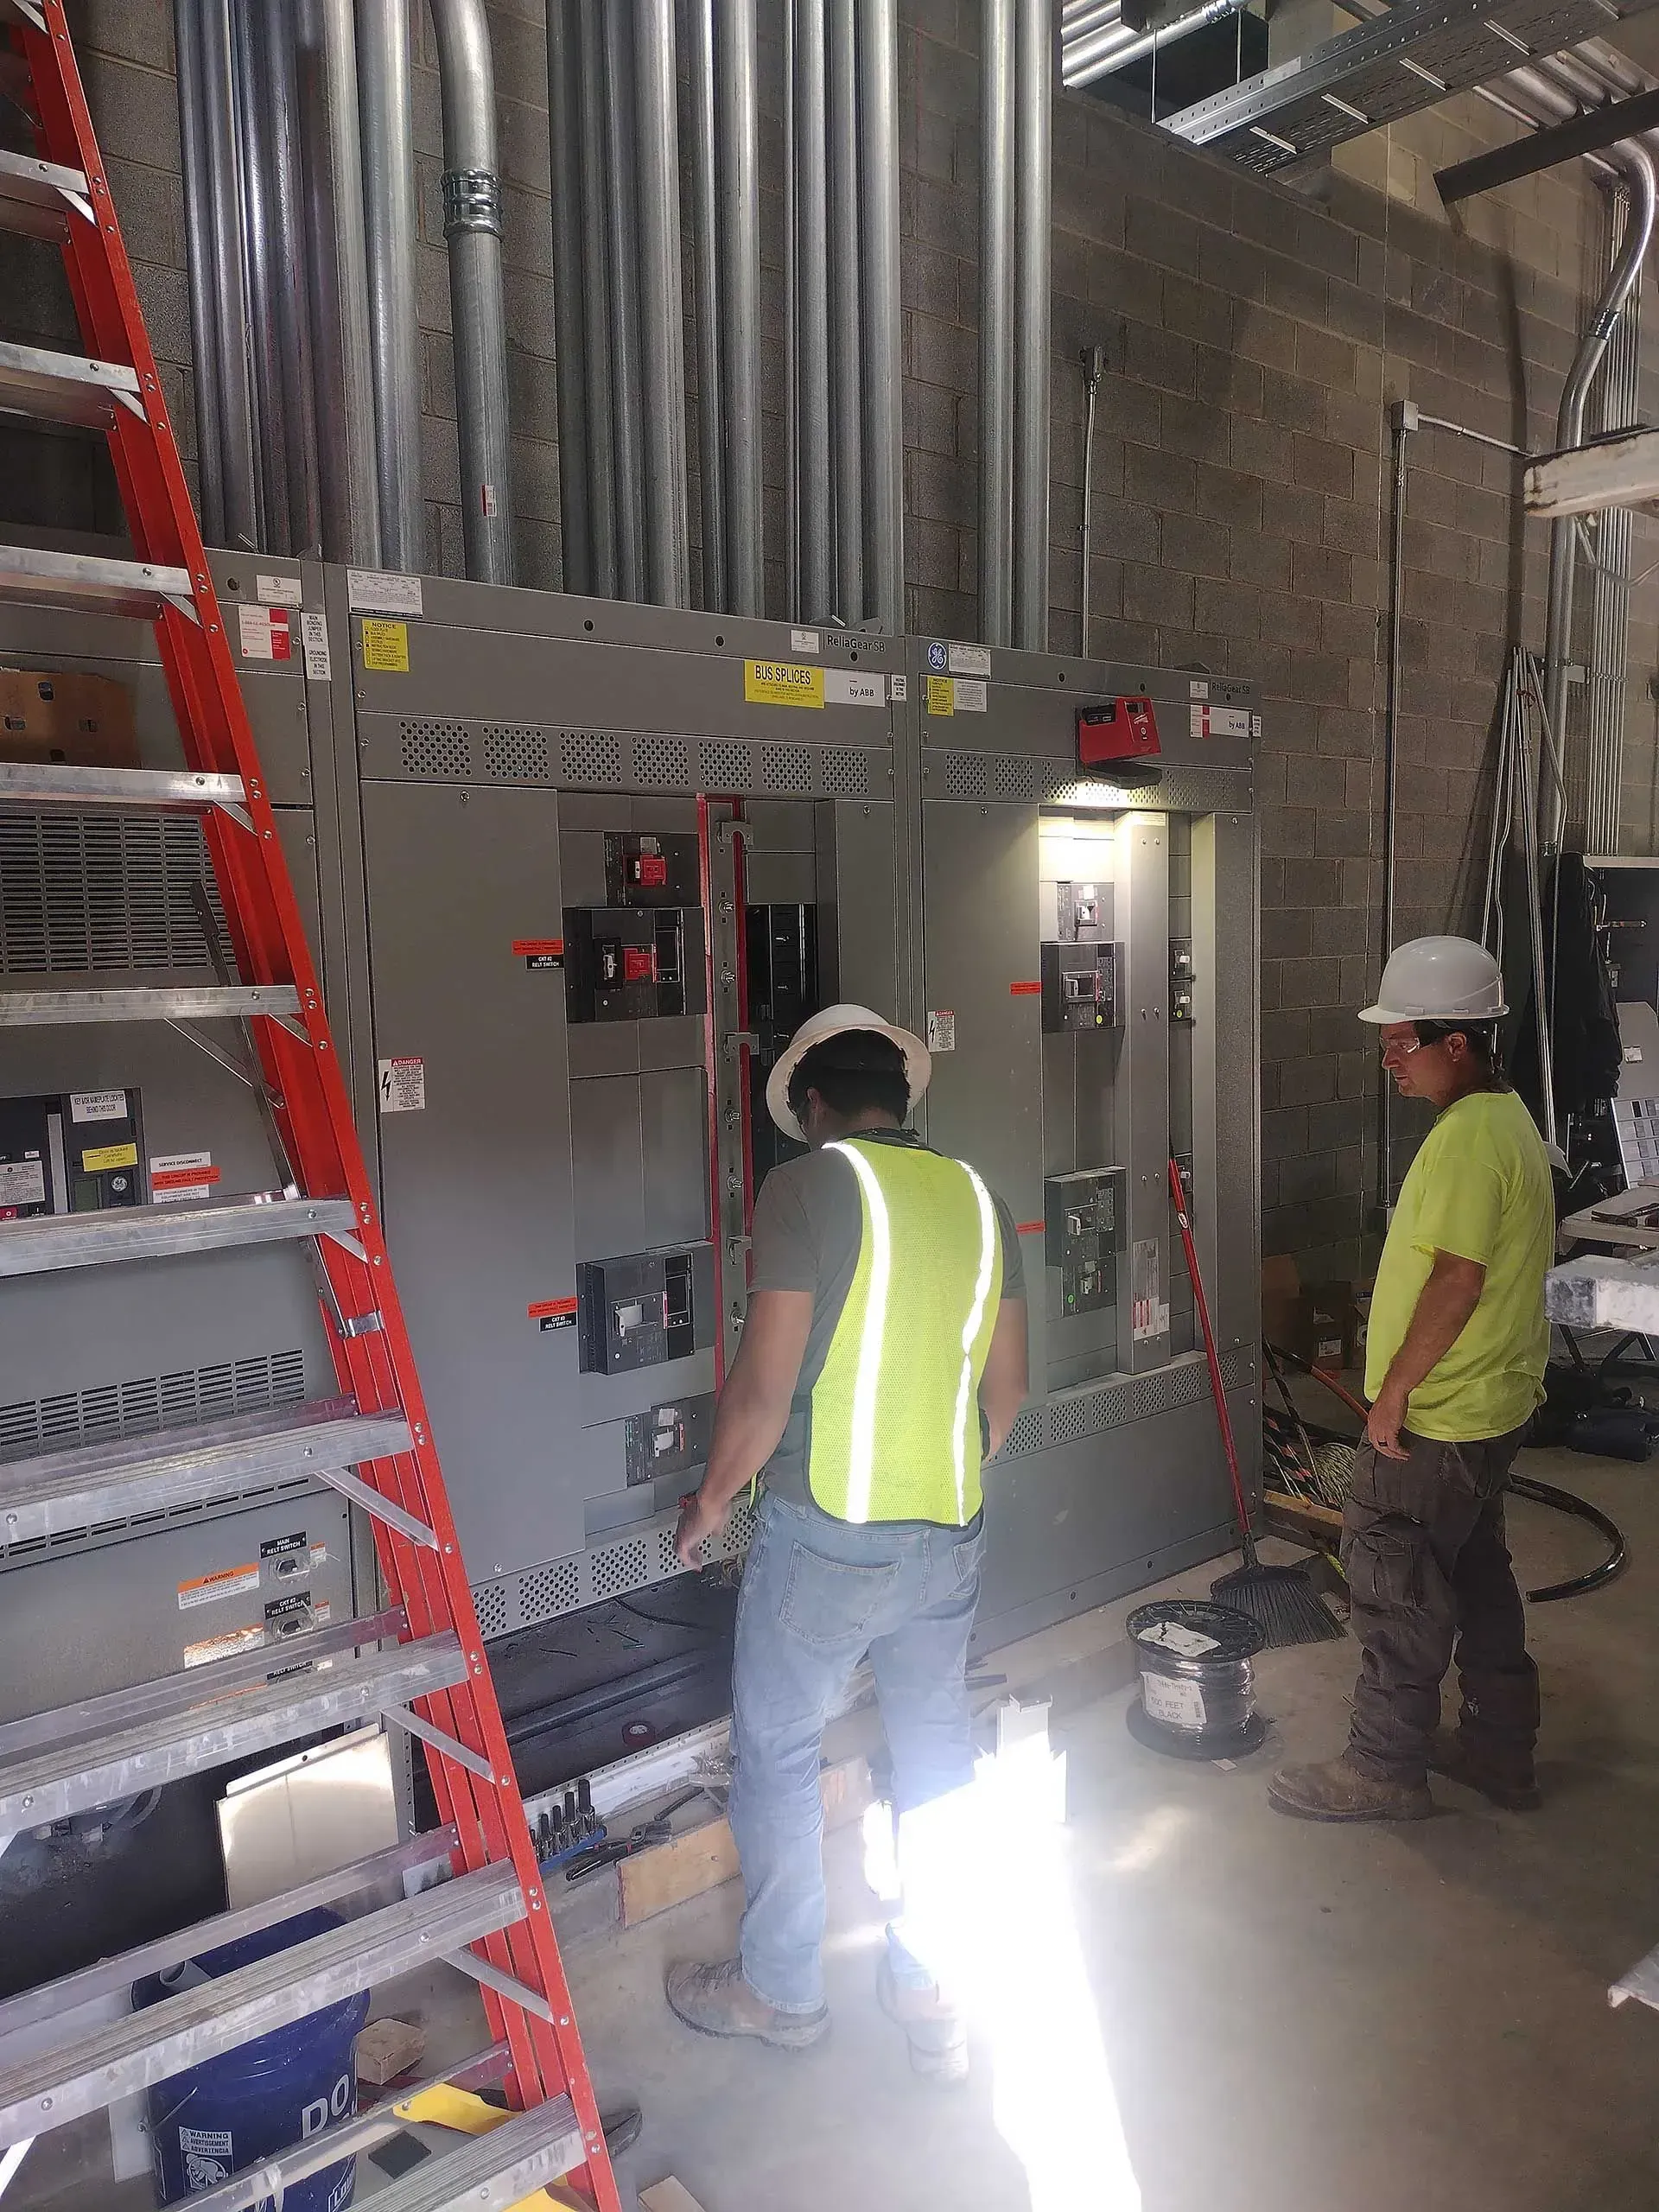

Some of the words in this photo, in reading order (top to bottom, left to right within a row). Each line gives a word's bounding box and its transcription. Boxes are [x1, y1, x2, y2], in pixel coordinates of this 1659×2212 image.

[827, 634, 873, 651] ReliaGear
[874, 641, 885, 652] SB
[755, 664, 773, 681] BUS
[775, 667, 811, 685] SPLICES
[849, 687, 859, 697] by
[859, 688, 874, 697] ABB
[1211, 682, 1242, 694] ReliaGear
[1242, 685, 1250, 695] SB
[1229, 721, 1235, 730] by
[1235, 721, 1245, 730] ABB
[276, 1537, 290, 1547] MAIN
[266, 1547, 280, 1555] RELT
[280, 1541, 301, 1552] SWITCH
[208, 1571, 234, 1582] WARNING
[279, 1599, 289, 1607] CKT
[271, 1606, 284, 1616] RELT
[1165, 1700, 1184, 1709] FEET
[1158, 1709, 1183, 1719] BLACK
[190, 2130, 229, 2139] WARNING
[190, 2138, 229, 2146] AVERTISSEMENT
[191, 2145, 229, 2154] ADVERTENCIA
